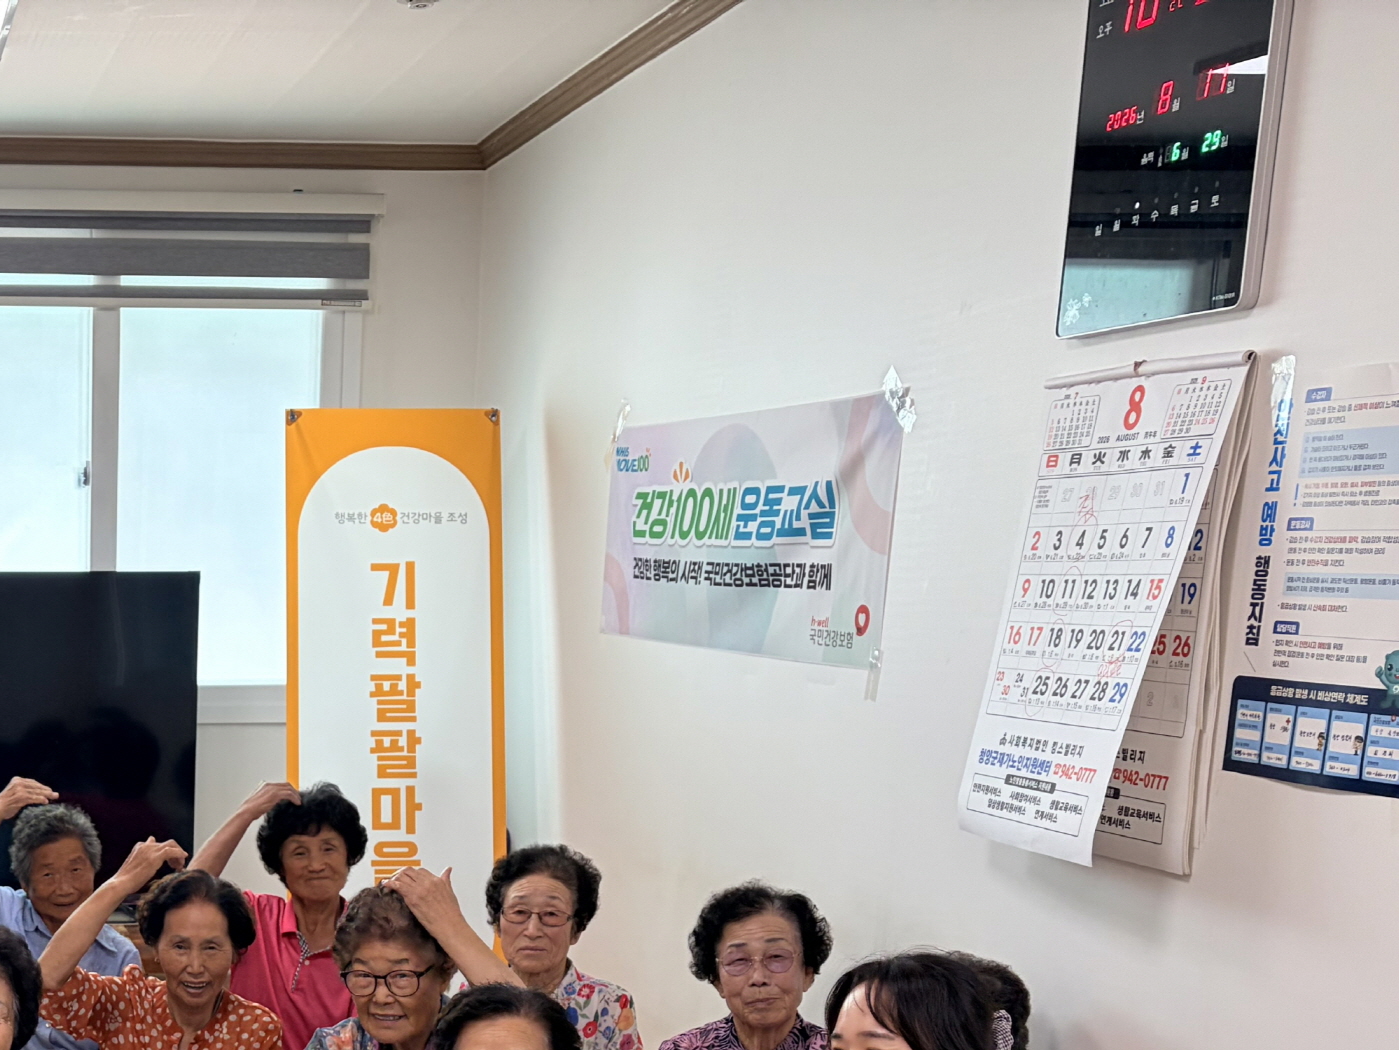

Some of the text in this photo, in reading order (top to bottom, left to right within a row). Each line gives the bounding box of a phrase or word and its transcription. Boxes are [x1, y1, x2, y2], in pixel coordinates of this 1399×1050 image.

[1096, 21, 1113, 39] 오후
[1150, 210, 1159, 222] 수
[1123, 384, 1146, 431] 8
[1097, 435, 1111, 444] 2026
[1115, 432, 1140, 443] AUGUST
[1046, 454, 1060, 468] 日
[1069, 453, 1083, 467] 月
[1091, 451, 1107, 466] 火
[1116, 449, 1131, 463] 水
[1161, 443, 1177, 459] 金
[1186, 441, 1203, 457] 土
[1181, 472, 1191, 494] 1
[334, 511, 368, 525] 행복한
[399, 511, 444, 525] 건강마을
[446, 511, 468, 525] 조성
[1244, 398, 1294, 647] 안전사고 예방 행동지침
[1030, 525, 1176, 551] 2 3 4 5 6 7 8
[633, 557, 833, 591] 건강한 행복의 시작! 국민건강보험공단과 함께
[1021, 578, 1164, 601] 9 10 11 12 13 14 15
[1180, 582, 1198, 605] 19
[811, 615, 830, 628] h-well
[809, 628, 854, 649] 국민건강보험
[1008, 625, 1147, 652] 16 17 18 19 20 21 22
[1171, 634, 1191, 658] 26
[996, 671, 1005, 682] 23
[1015, 672, 1025, 683] 24
[1031, 674, 1051, 696] 25
[1052, 676, 1070, 698] 26
[1070, 678, 1090, 700] 27
[1089, 680, 1109, 702] 28
[1108, 681, 1129, 704] 29
[1001, 684, 1029, 698] 30 31
[1270, 685, 1369, 706] 응급상황 발생 시 비상연락 체계도
[1008, 734, 1049, 753] 사회복지법인
[978, 748, 1097, 784] 청양군재가노인지원센터 942-0777
[1122, 768, 1170, 791] 942-0777
[1100, 814, 1131, 830] 연계서비스
[1117, 805, 1162, 823] 생활교육서비스
